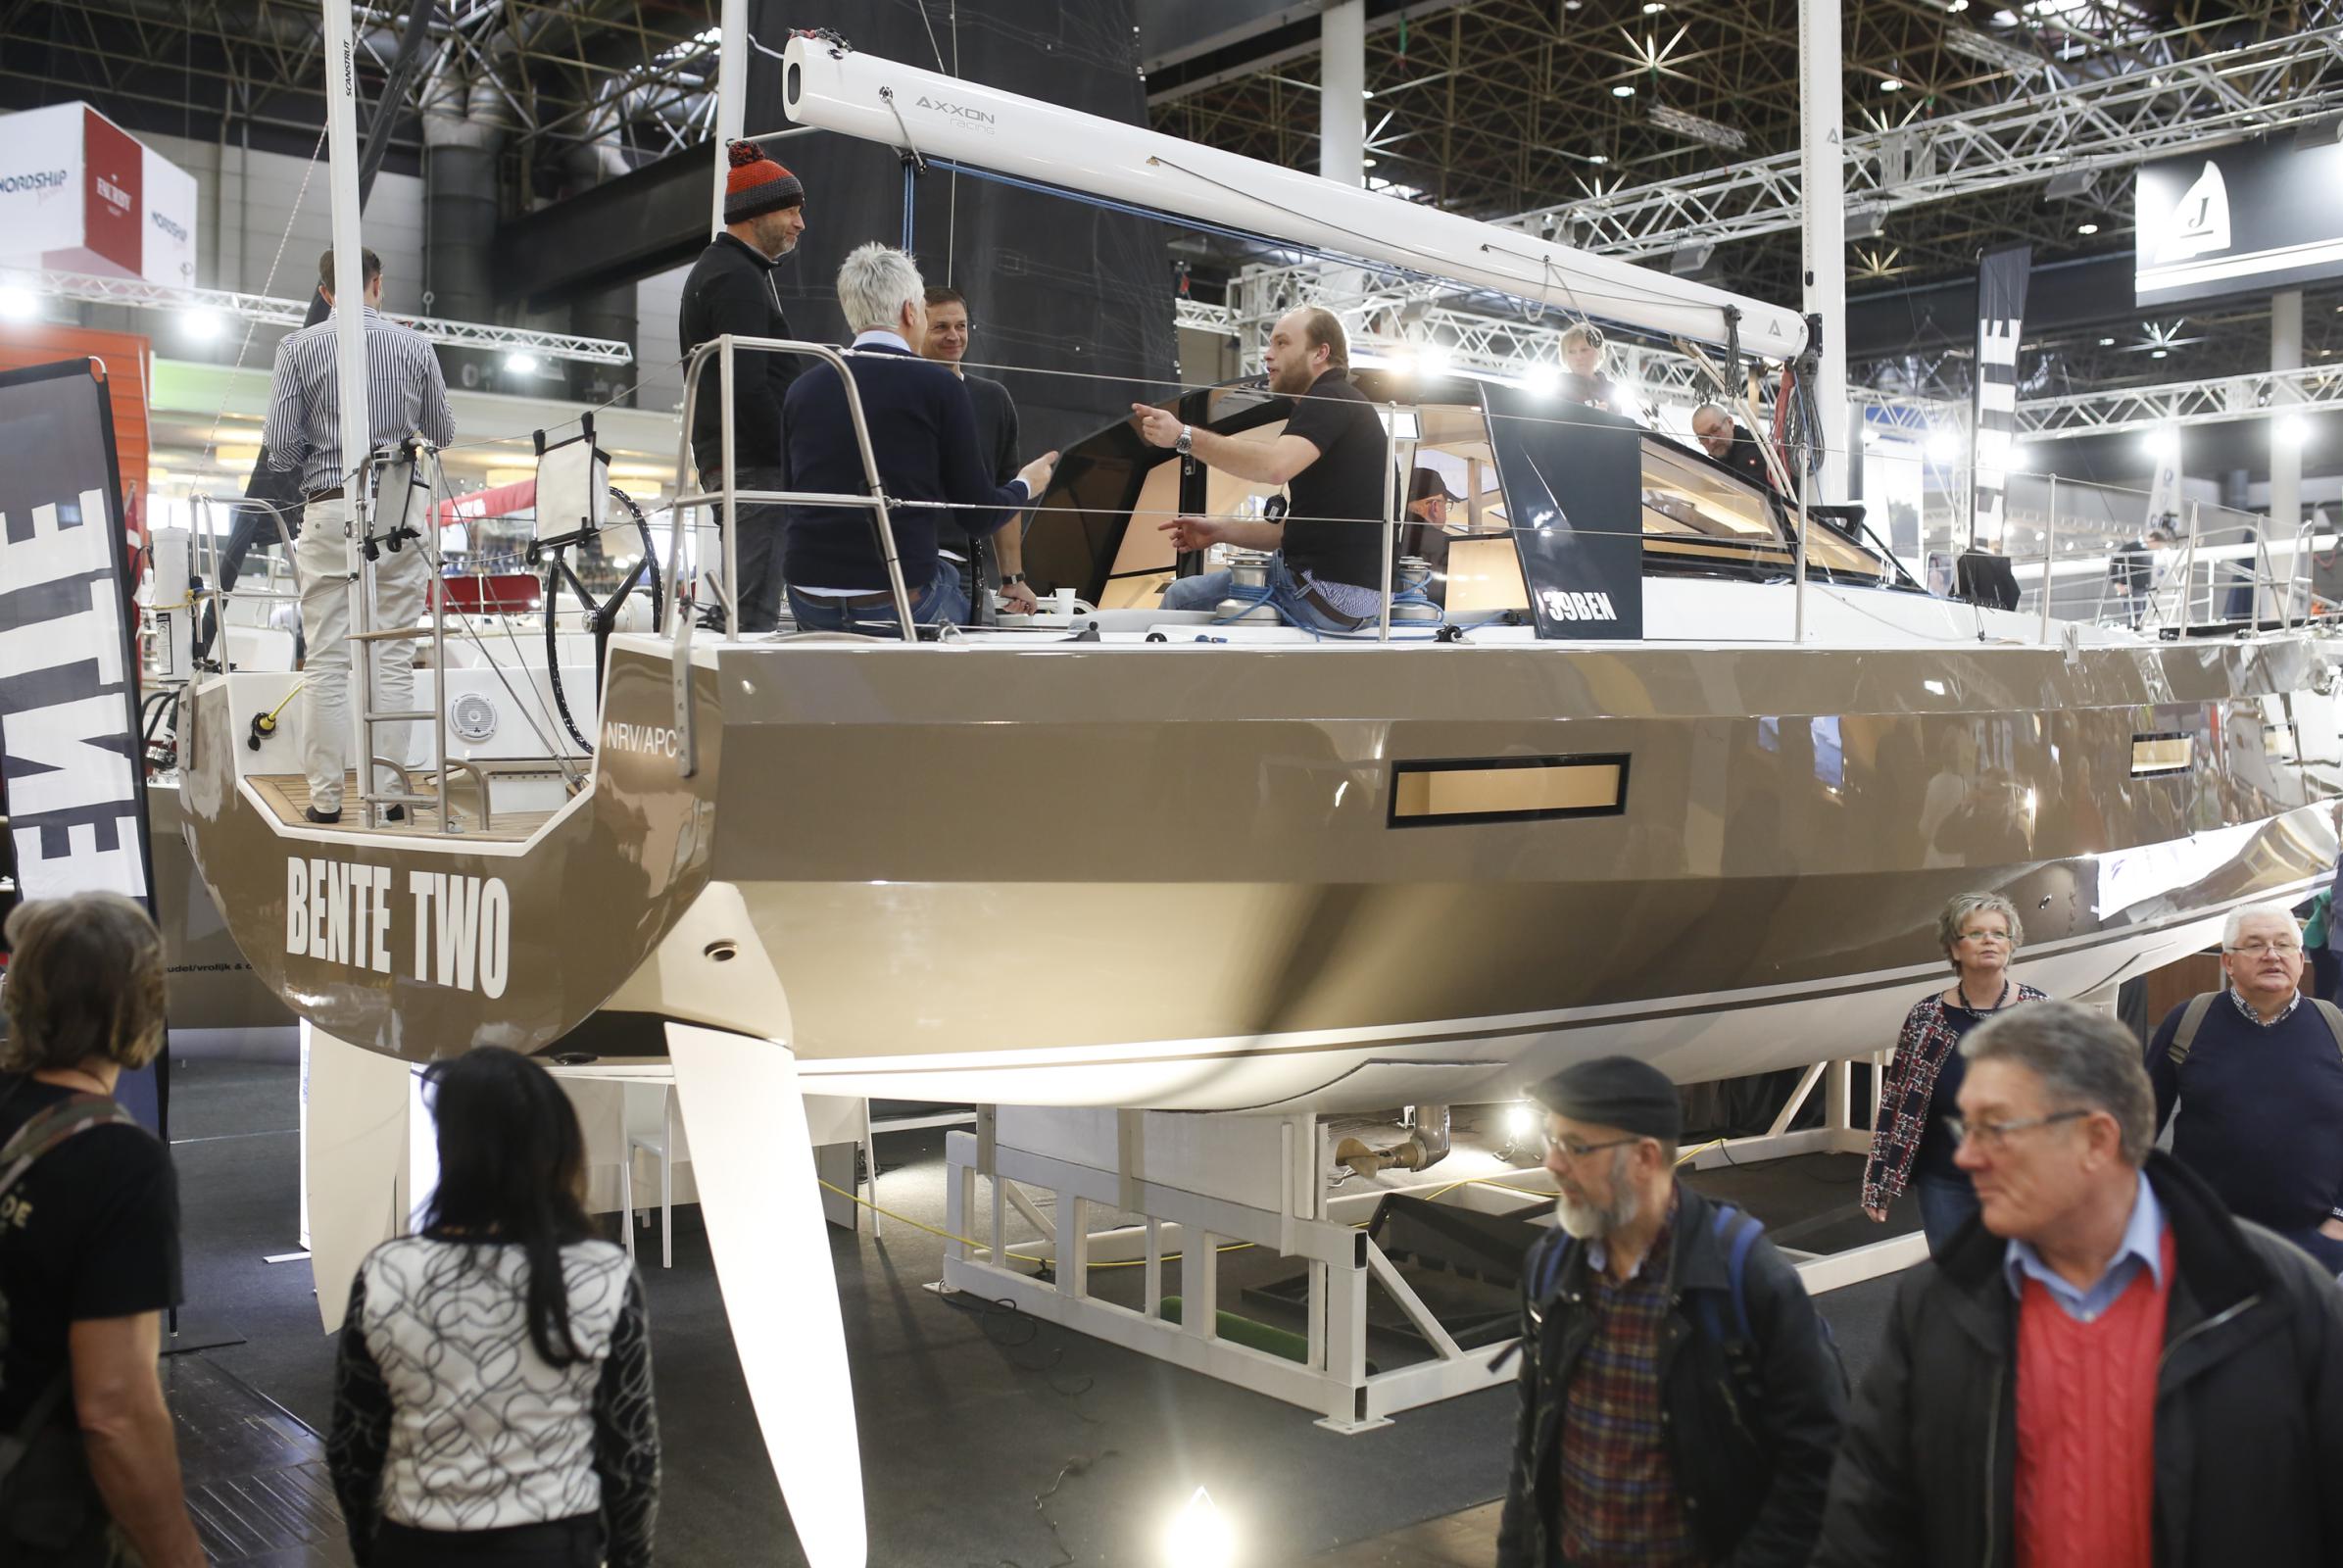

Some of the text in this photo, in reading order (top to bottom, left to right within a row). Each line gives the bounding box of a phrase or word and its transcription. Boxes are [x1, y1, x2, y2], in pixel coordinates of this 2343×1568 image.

[344, 39, 353, 98] SCANSTRUT
[915, 96, 995, 124] AXXON
[2187, 196, 2210, 228] J
[286, 856, 510, 1000] BENTE TWO
[167, 962, 231, 974] udel/vrolijk
